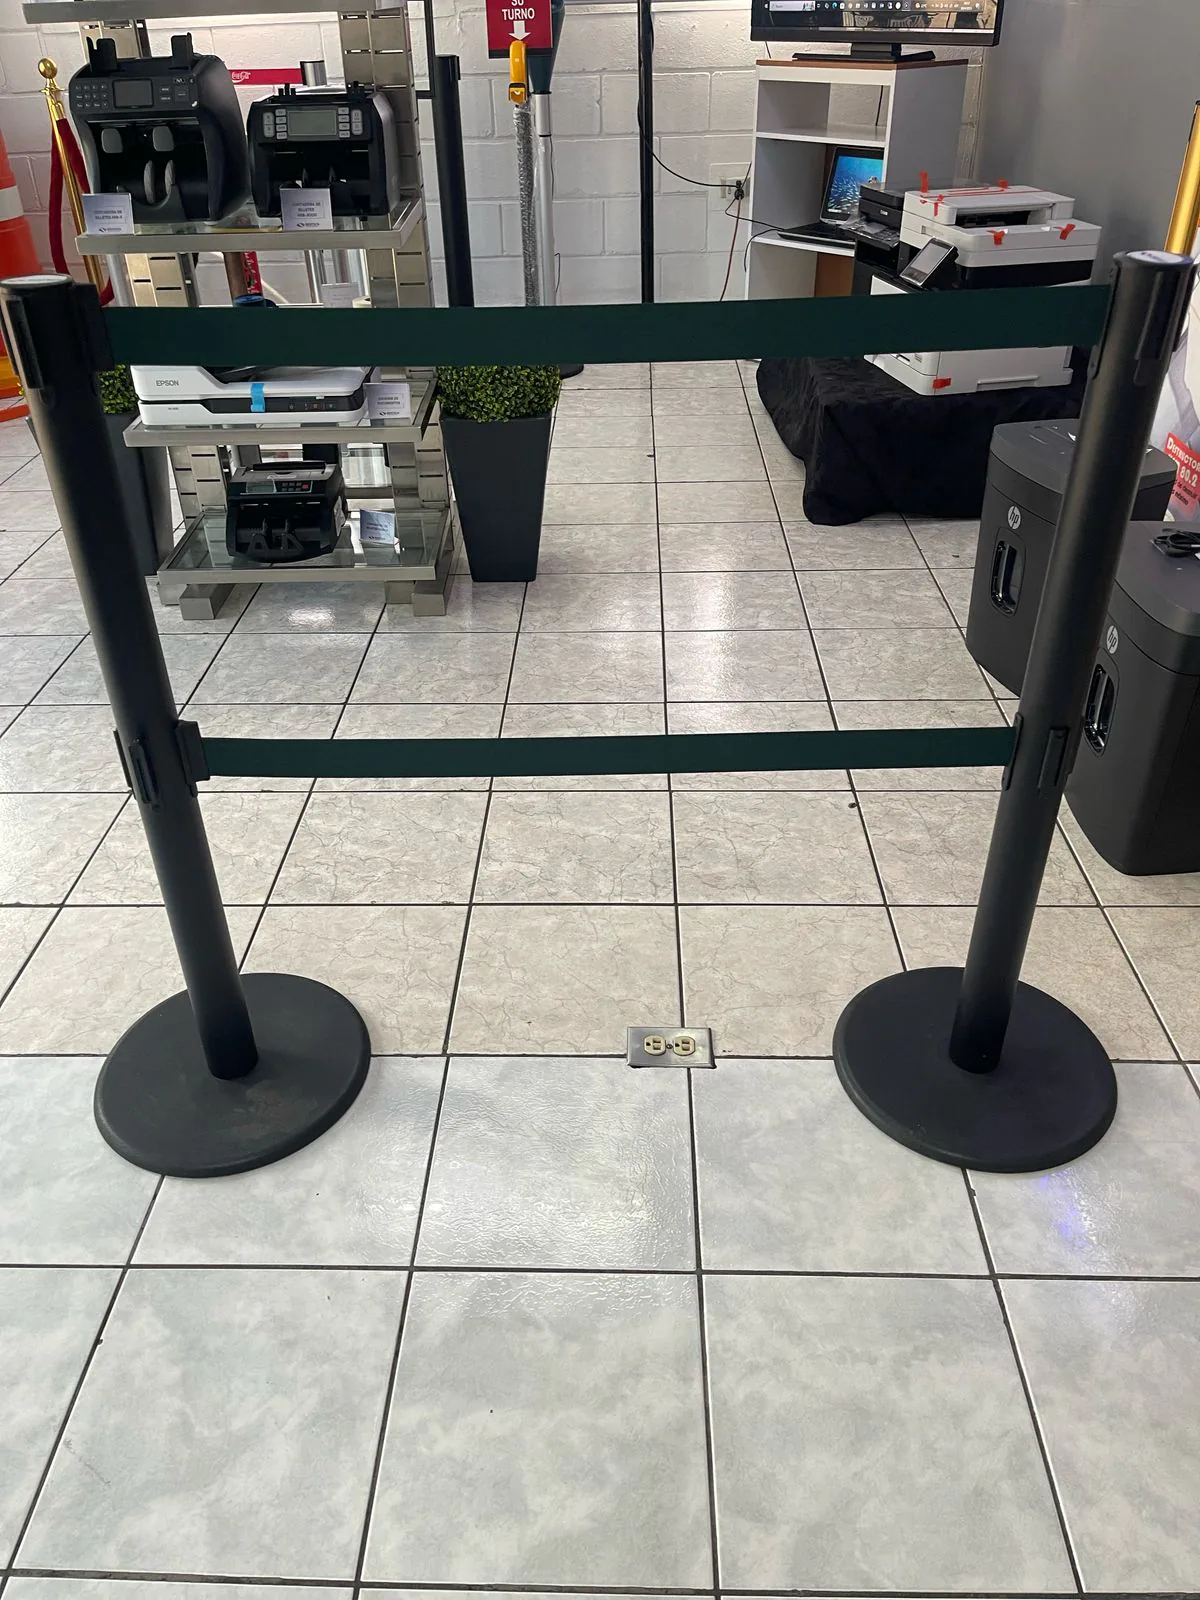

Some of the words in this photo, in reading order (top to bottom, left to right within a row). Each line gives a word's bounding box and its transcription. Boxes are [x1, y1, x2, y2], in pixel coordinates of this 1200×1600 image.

[501, 8, 535, 20] TURNO
[155, 379, 179, 387] EPSON
[1008, 505, 1021, 530] hp
[1107, 625, 1119, 654] hp
